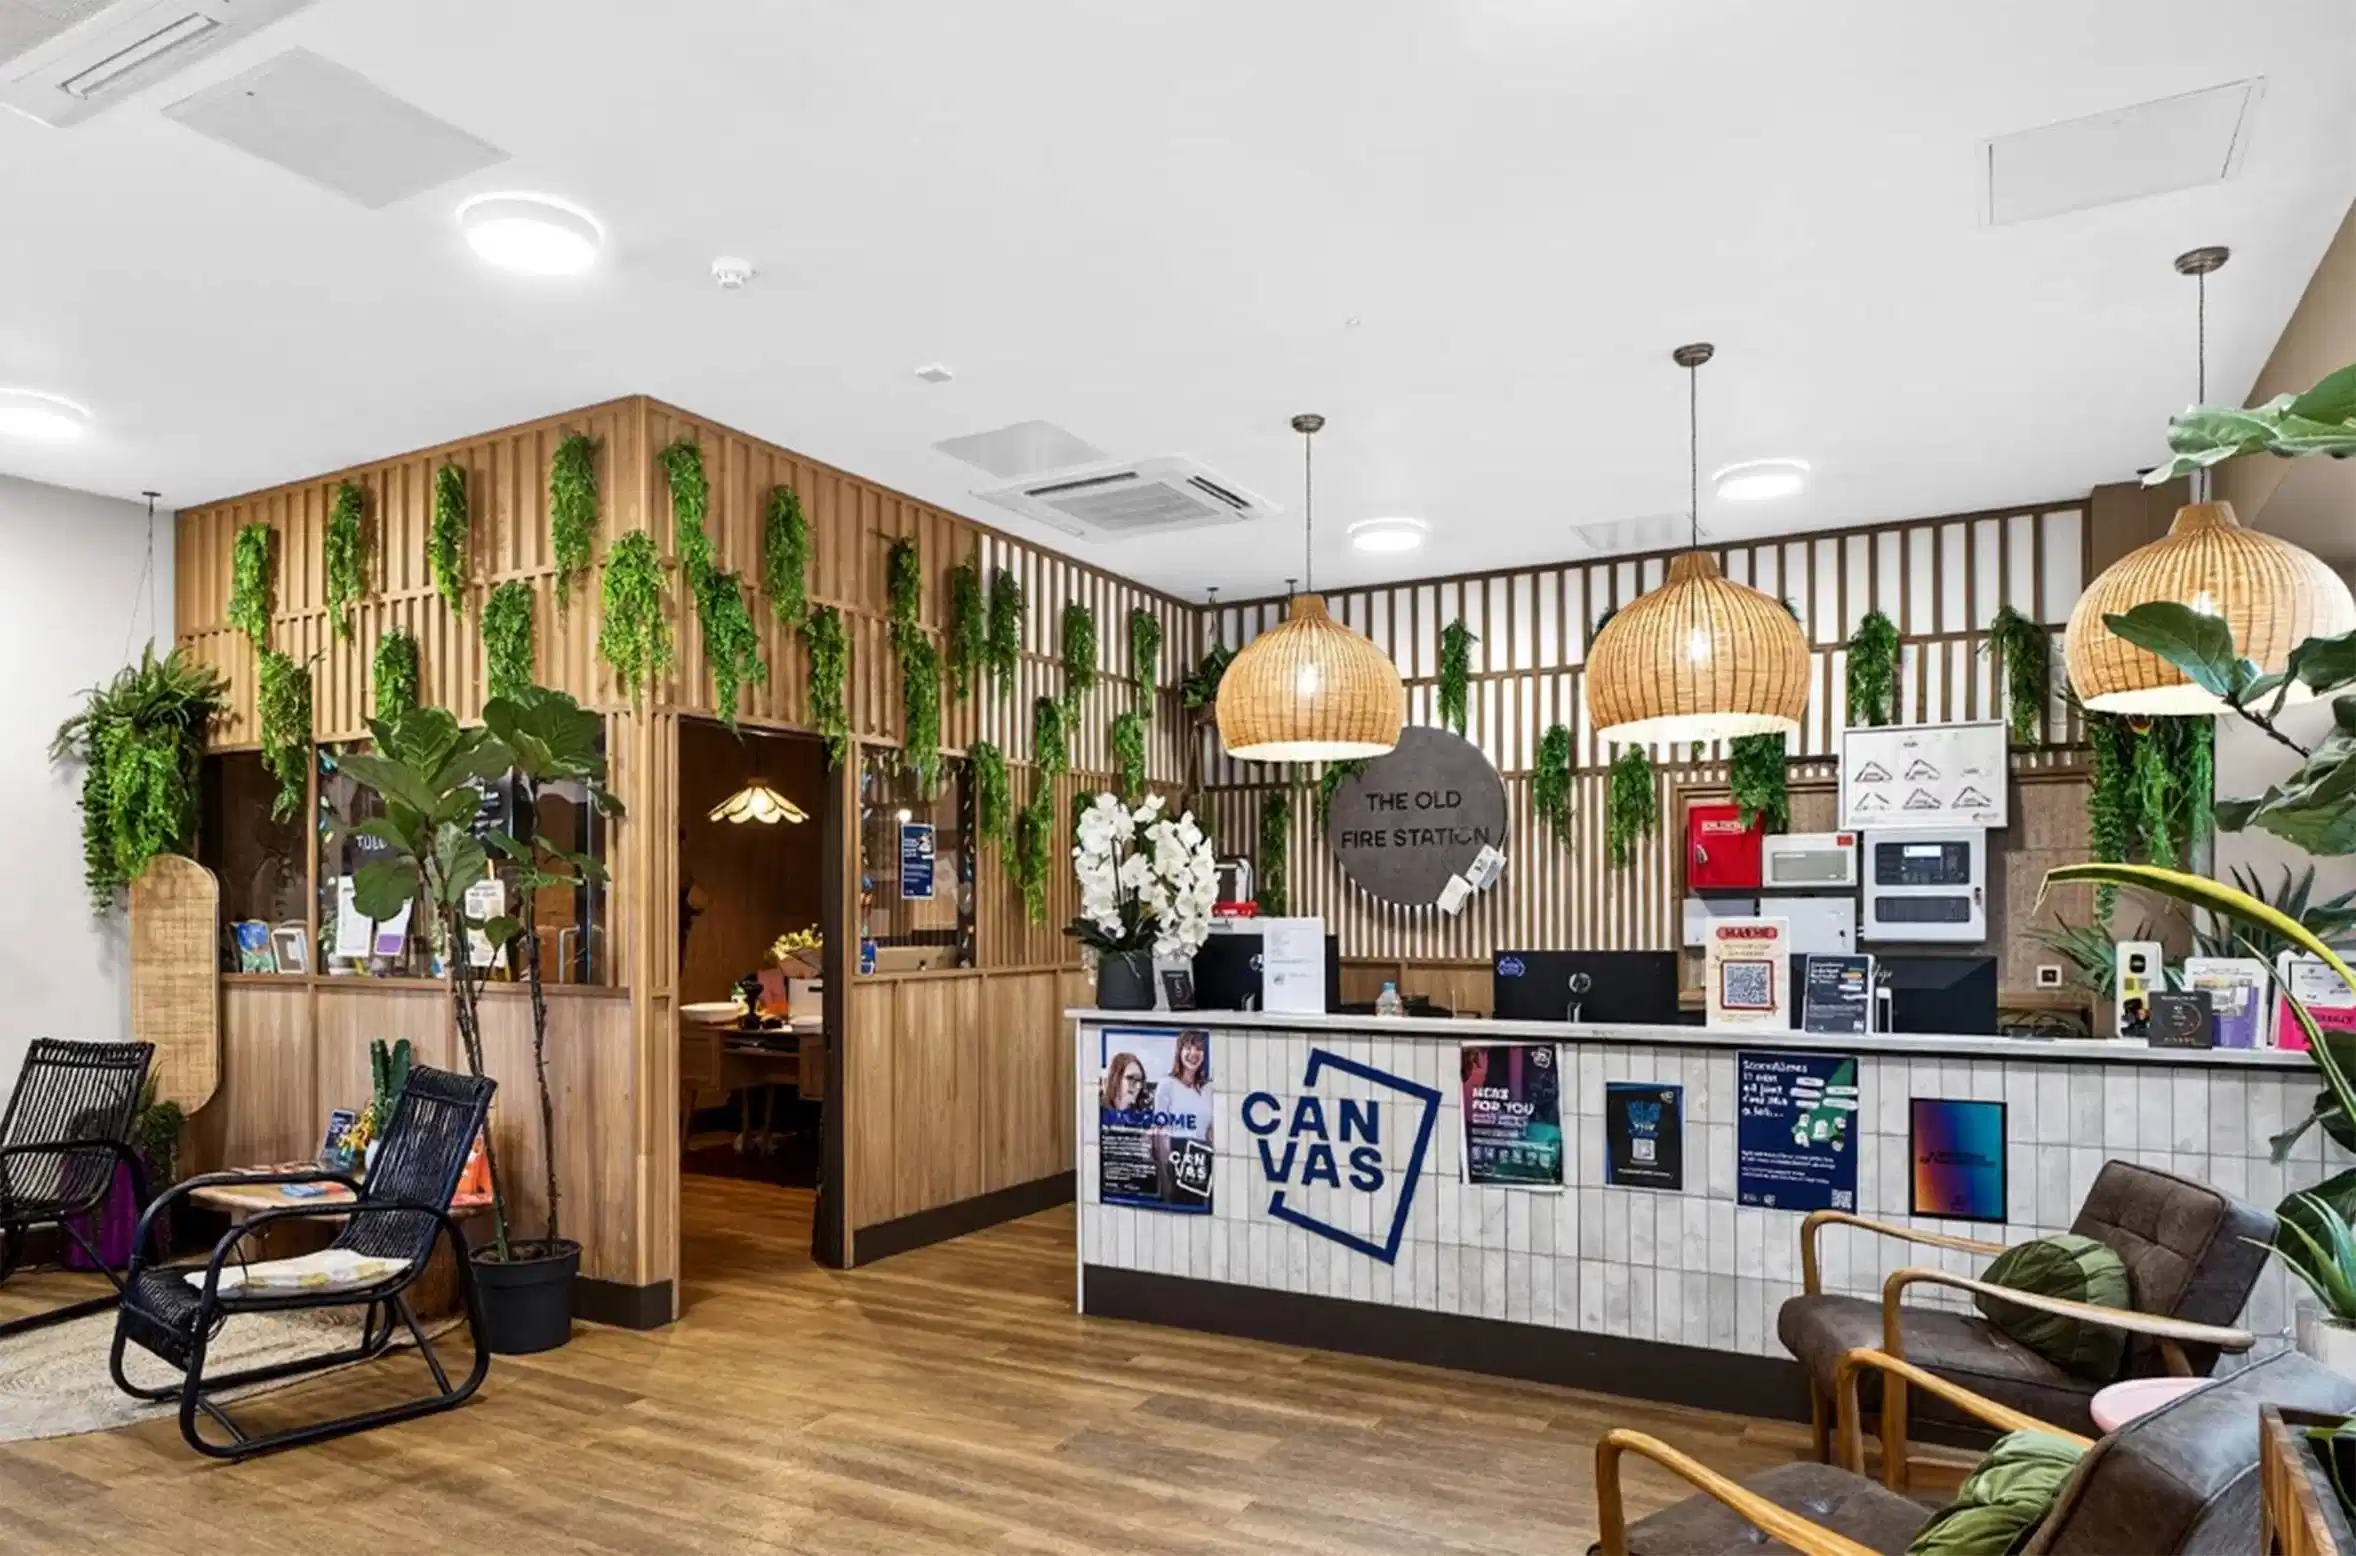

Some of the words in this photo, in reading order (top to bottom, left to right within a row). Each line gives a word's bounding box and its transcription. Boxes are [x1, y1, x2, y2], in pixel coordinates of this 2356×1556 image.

[1366, 792, 1408, 811] THE
[1414, 791, 1463, 810] OLD
[1341, 830, 1387, 849] FIRE
[1393, 826, 1491, 847] STATION
[1103, 1107, 1197, 1130] COME
[1241, 1091, 1380, 1145] CAN
[1504, 1101, 1535, 1116] YOU
[1257, 1138, 1385, 1193] VAS
